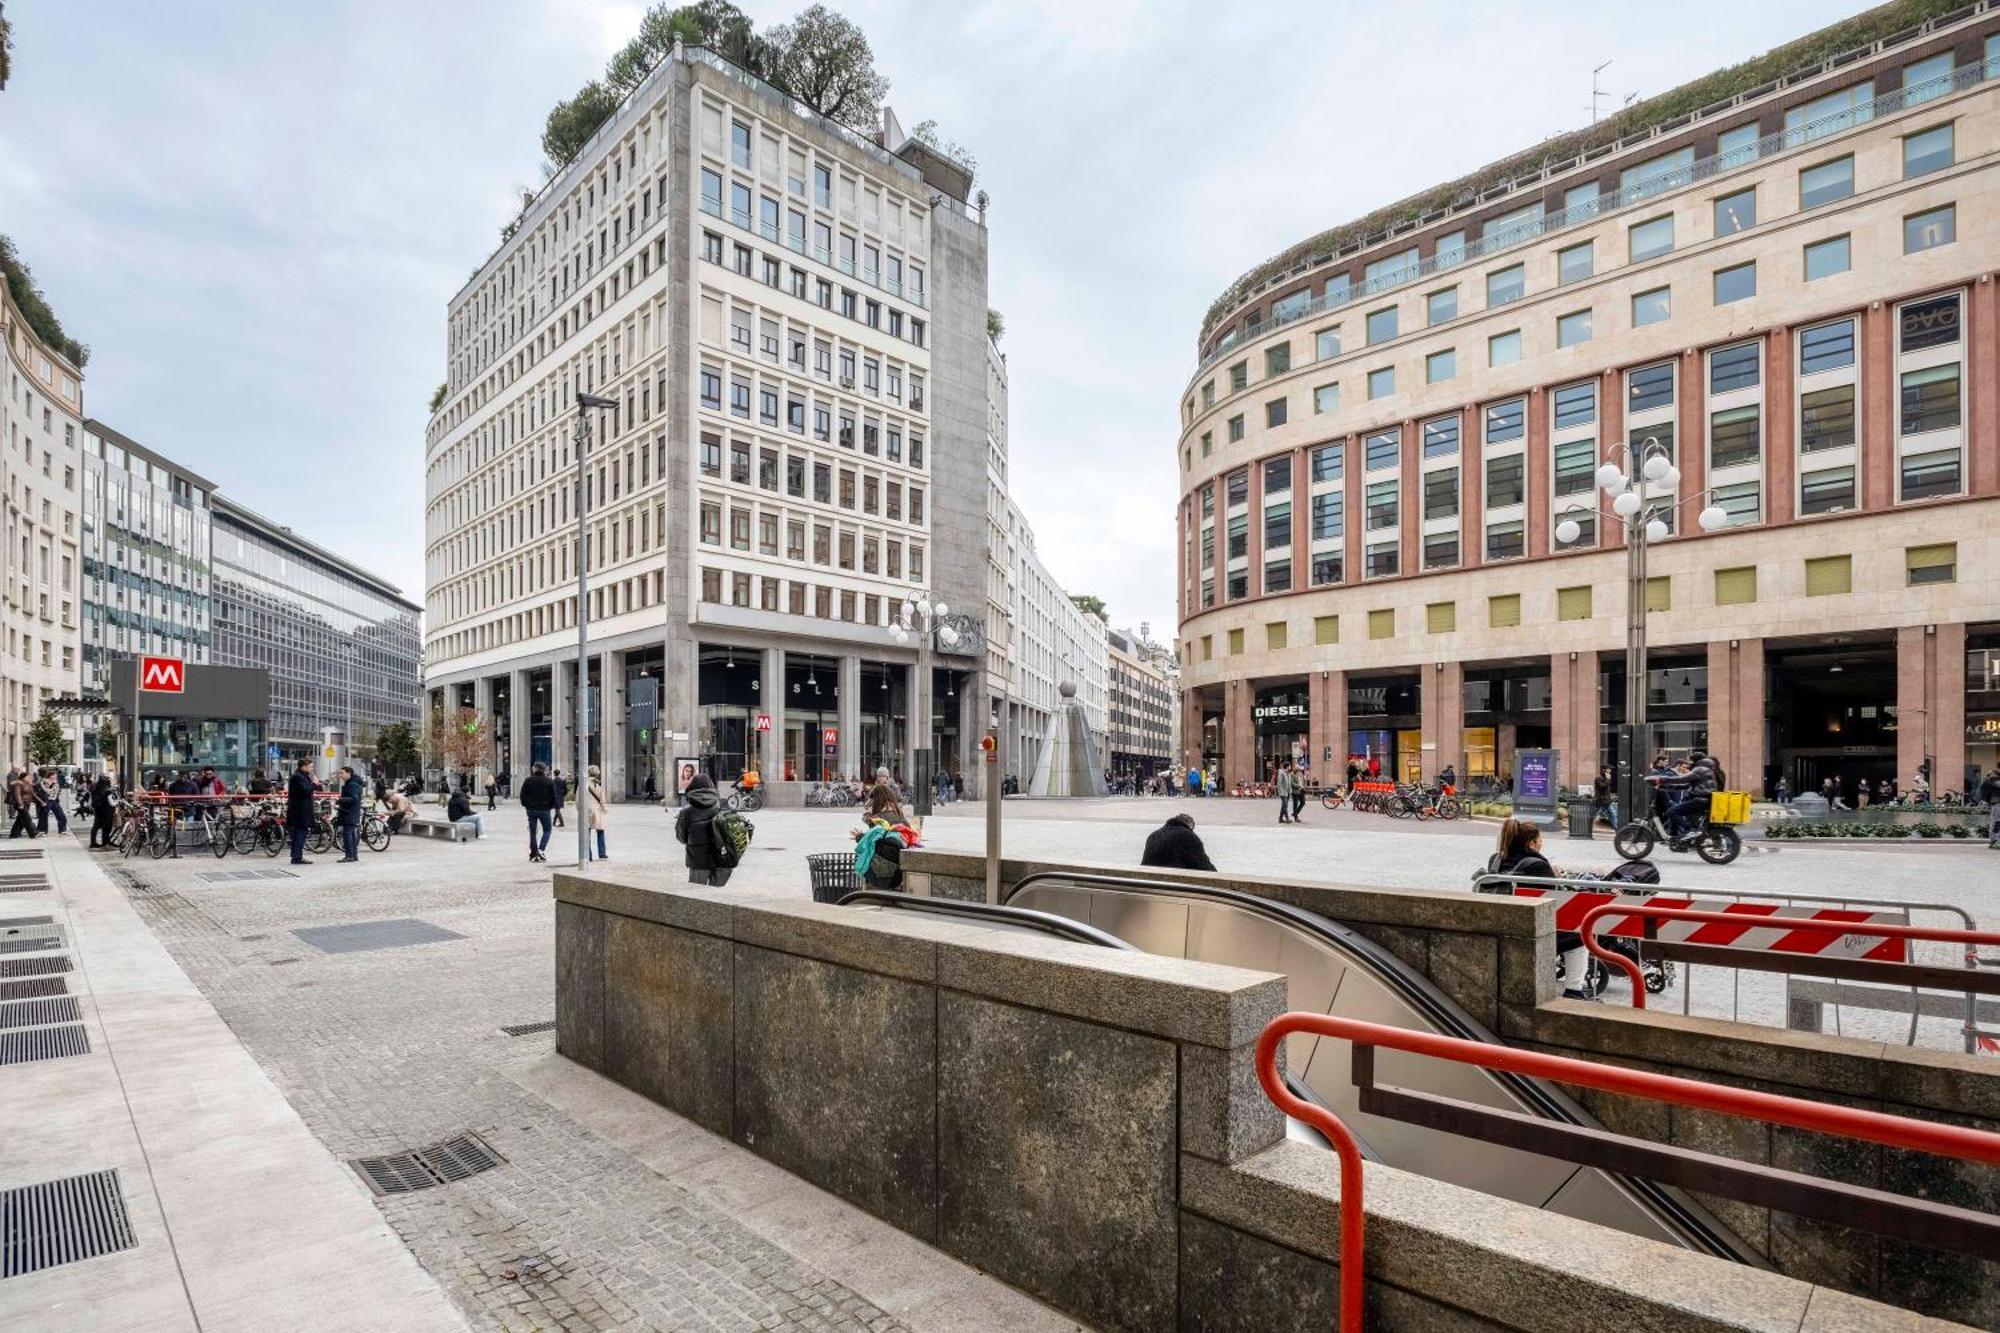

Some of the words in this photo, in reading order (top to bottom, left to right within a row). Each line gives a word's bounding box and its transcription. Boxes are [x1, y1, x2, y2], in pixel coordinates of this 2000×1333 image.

[145, 664, 180, 686] M
[752, 680, 840, 696] SSLE
[1255, 705, 1308, 717] DIESEL
[758, 717, 770, 729] M
[825, 732, 836, 741] M
